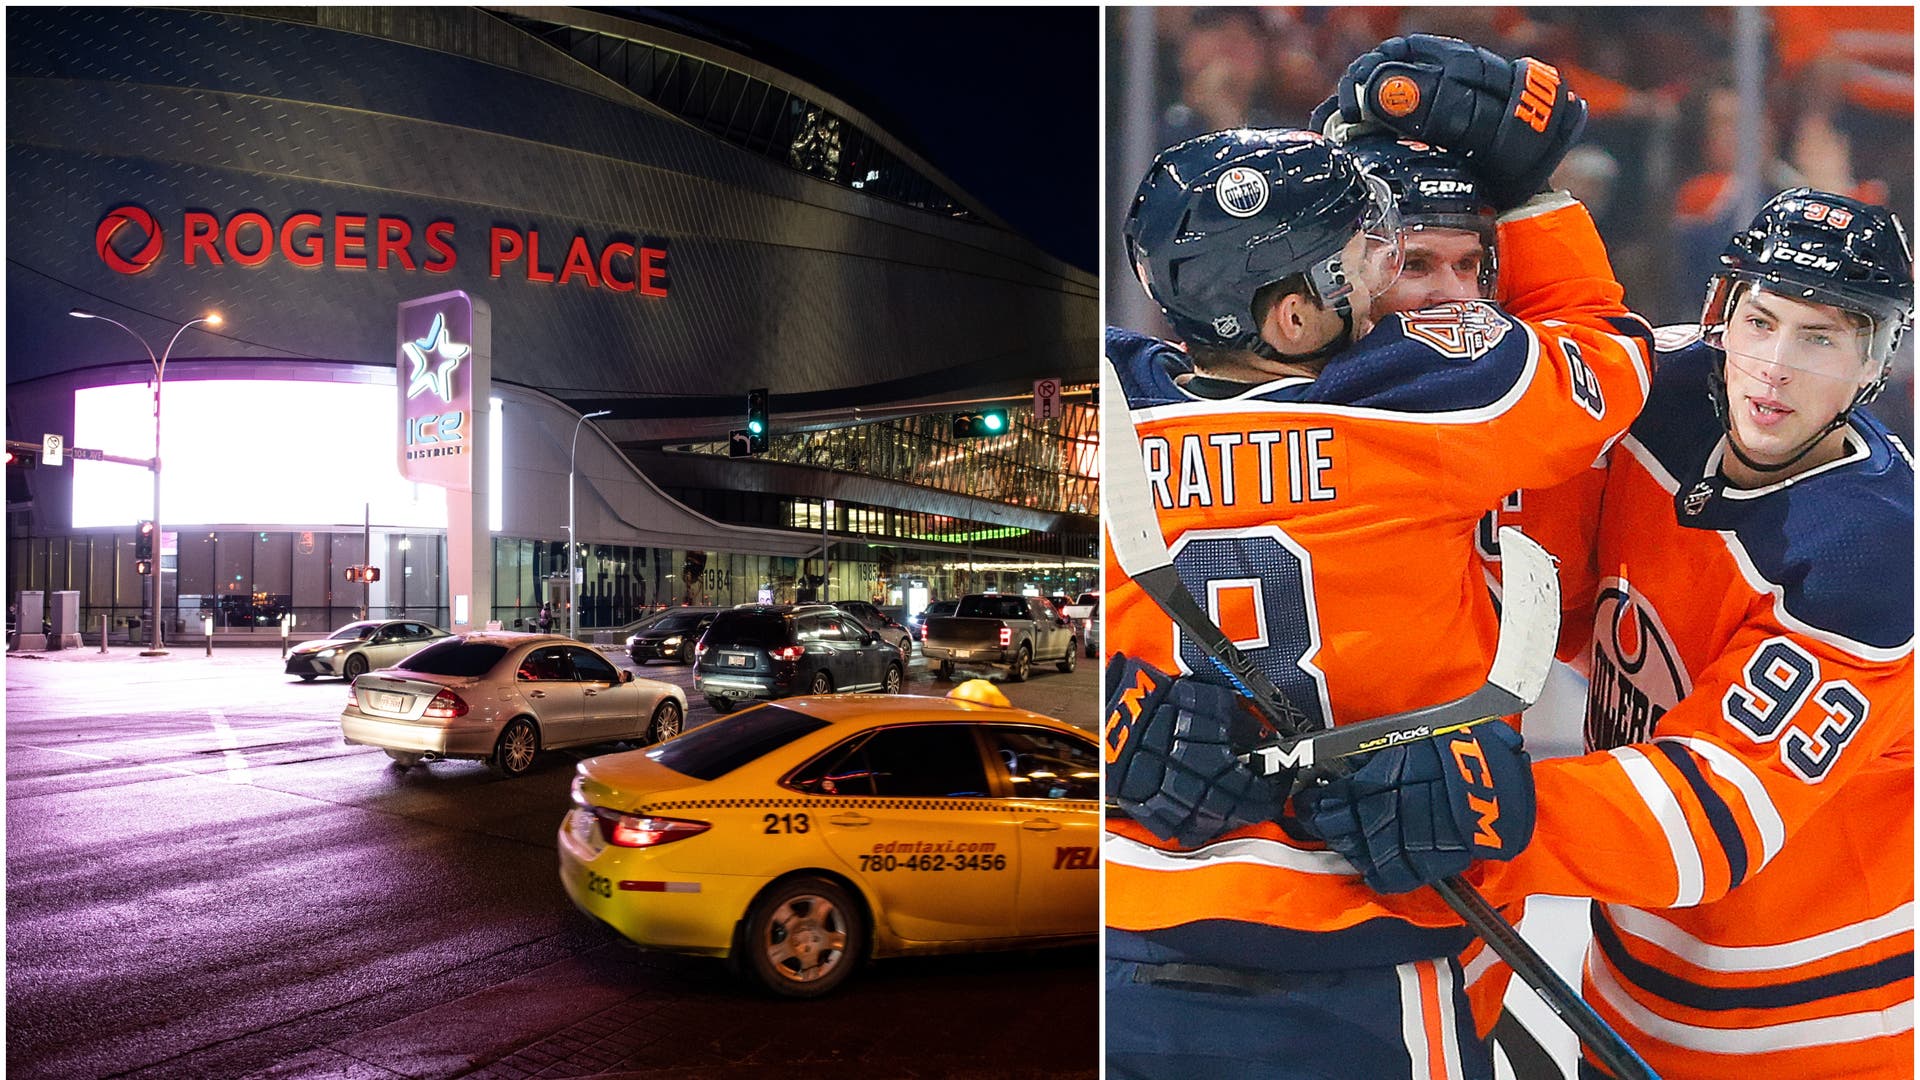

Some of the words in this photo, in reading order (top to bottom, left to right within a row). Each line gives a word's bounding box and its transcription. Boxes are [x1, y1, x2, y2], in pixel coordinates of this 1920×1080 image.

[1803, 201, 1854, 230] 93
[183, 212, 459, 274] ROGERS
[490, 227, 668, 298] PLACE
[1773, 247, 1839, 272] CCM
[406, 445, 463, 460] DISTRICT
[1142, 427, 1336, 510] RATTIE
[704, 568, 730, 591] 1984
[859, 563, 877, 582] 1985
[1721, 635, 1871, 786] 93
[763, 813, 810, 835] 213
[872, 840, 998, 854] edmtaxi.com
[859, 854, 1007, 872] 780-462-3456
[587, 871, 612, 898] 213
